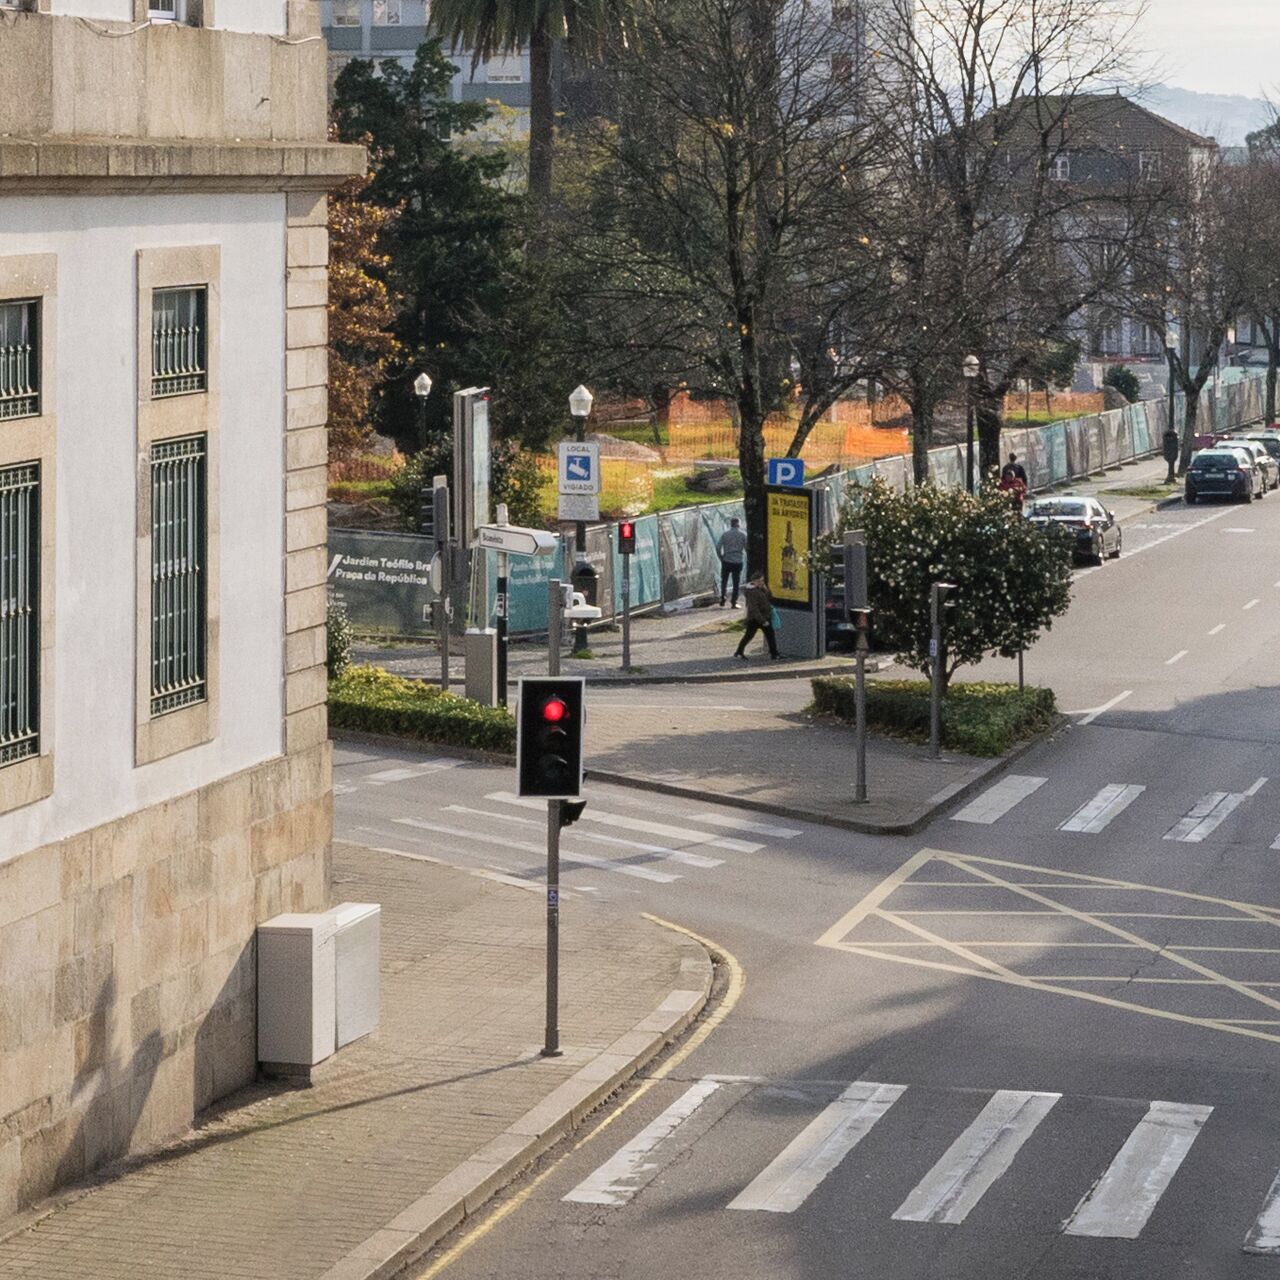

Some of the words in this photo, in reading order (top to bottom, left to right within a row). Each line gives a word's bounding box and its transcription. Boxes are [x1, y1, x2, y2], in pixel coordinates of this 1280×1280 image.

[566, 445, 591, 453] LOCAL
[775, 463, 796, 485] P
[342, 555, 378, 567] Jardim
[380, 557, 414, 570] Teófilo
[415, 560, 431, 571] Bra
[335, 568, 363, 581] Praça
[364, 571, 376, 581] da
[378, 572, 427, 585] República
